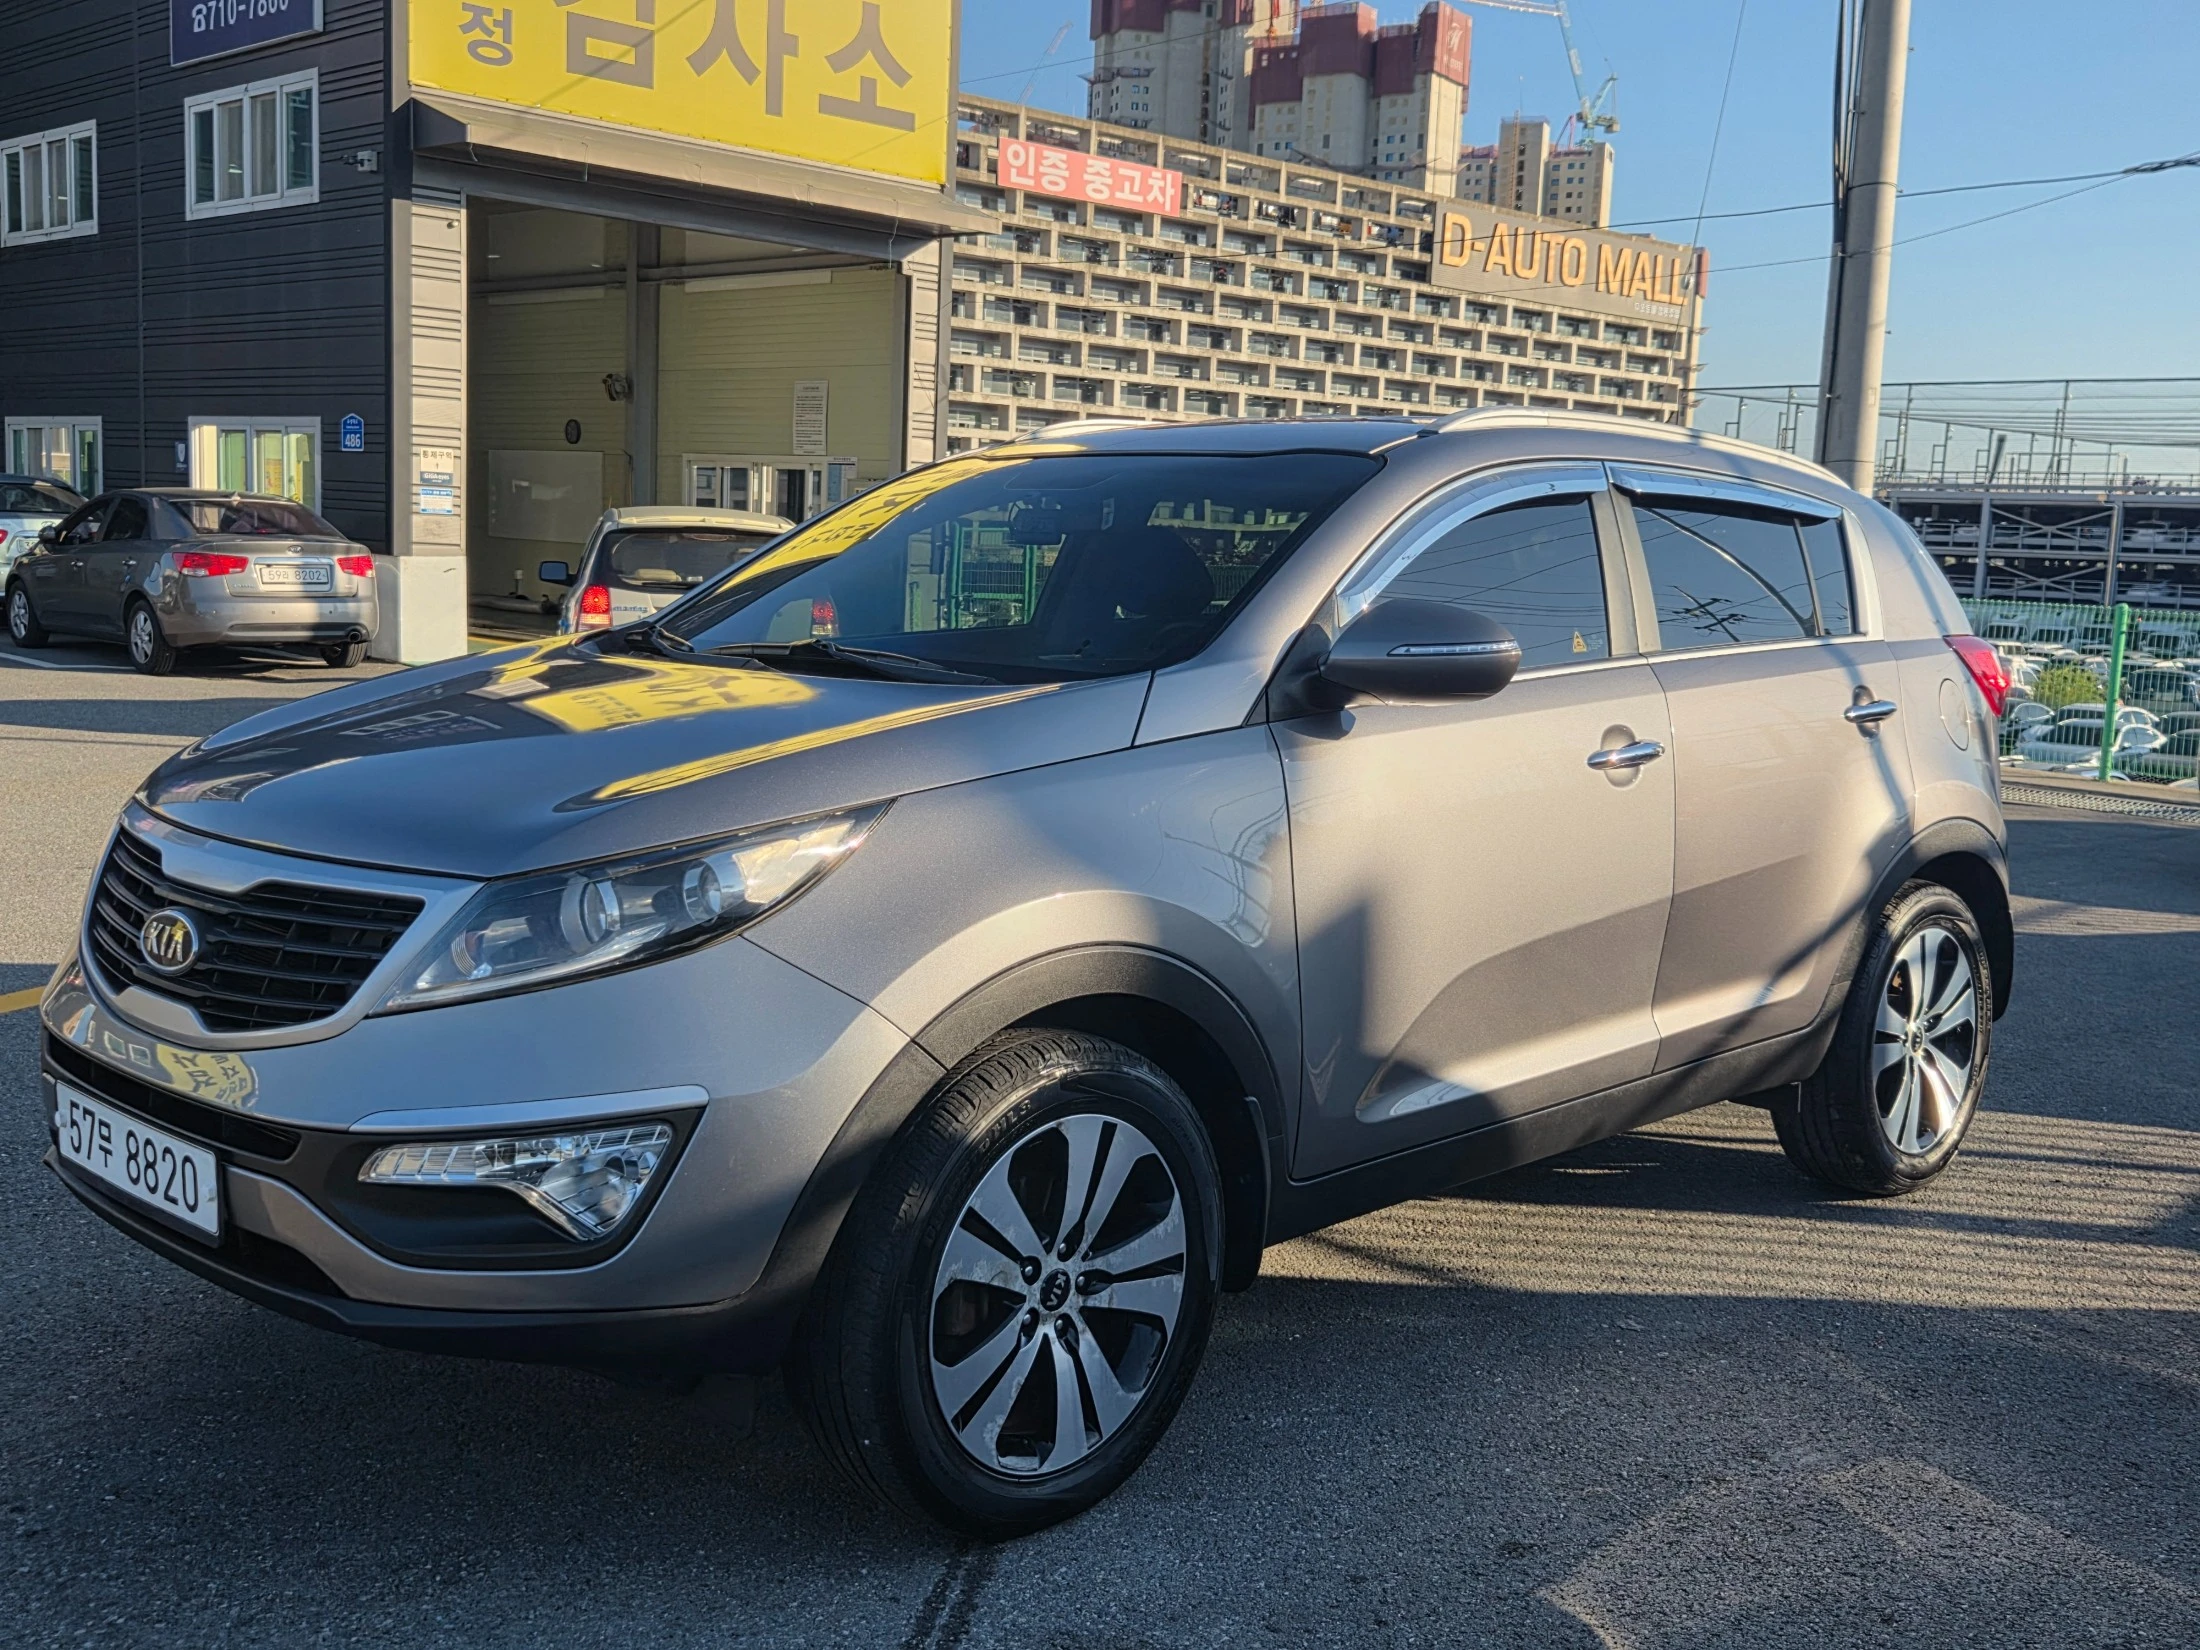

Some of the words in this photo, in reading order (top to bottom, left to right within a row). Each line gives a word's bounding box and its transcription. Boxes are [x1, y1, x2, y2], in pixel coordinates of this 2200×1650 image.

[1006, 143, 1070, 193] 인증
[1083, 158, 1175, 212] 중고차
[1441, 211, 1588, 287] D-AUTO
[1597, 243, 1688, 306] MALL
[345, 434, 361, 447] 486
[294, 569, 322, 581] 8202
[144, 921, 184, 962] KIA
[69, 1099, 113, 1168] 57무
[126, 1129, 199, 1213] 8820
